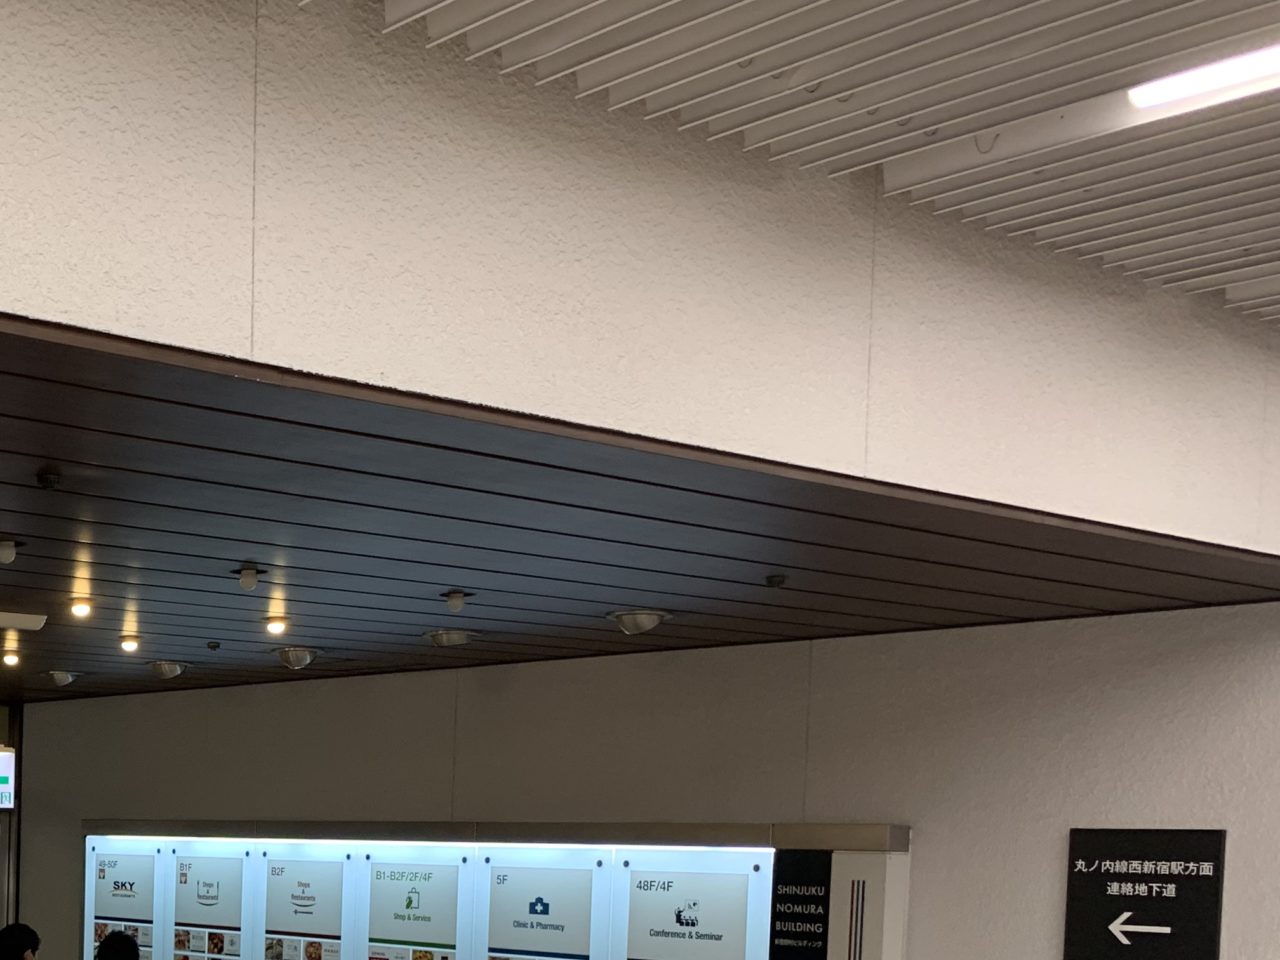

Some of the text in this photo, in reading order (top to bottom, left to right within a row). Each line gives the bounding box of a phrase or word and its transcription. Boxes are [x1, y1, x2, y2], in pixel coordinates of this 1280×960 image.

[180, 863, 192, 872] B1F
[271, 867, 285, 876] B2F
[1074, 859, 1214, 876] 丸ノ内線西新宿駅方面
[375, 870, 433, 882] B1-B2F/2F/4F
[496, 875, 508, 885] 5F
[112, 880, 136, 891] SKY
[636, 880, 673, 892] 48F/4F
[777, 884, 825, 896] SHINJUKU
[1106, 881, 1176, 898] 連絡地下道
[776, 903, 824, 915] NOMURA
[393, 912, 406, 921] Shop
[412, 914, 431, 922] Service
[513, 920, 565, 932] Clinic & Pharmacy
[775, 921, 823, 933] BUILDING
[649, 929, 723, 941] Conference & Seminar
